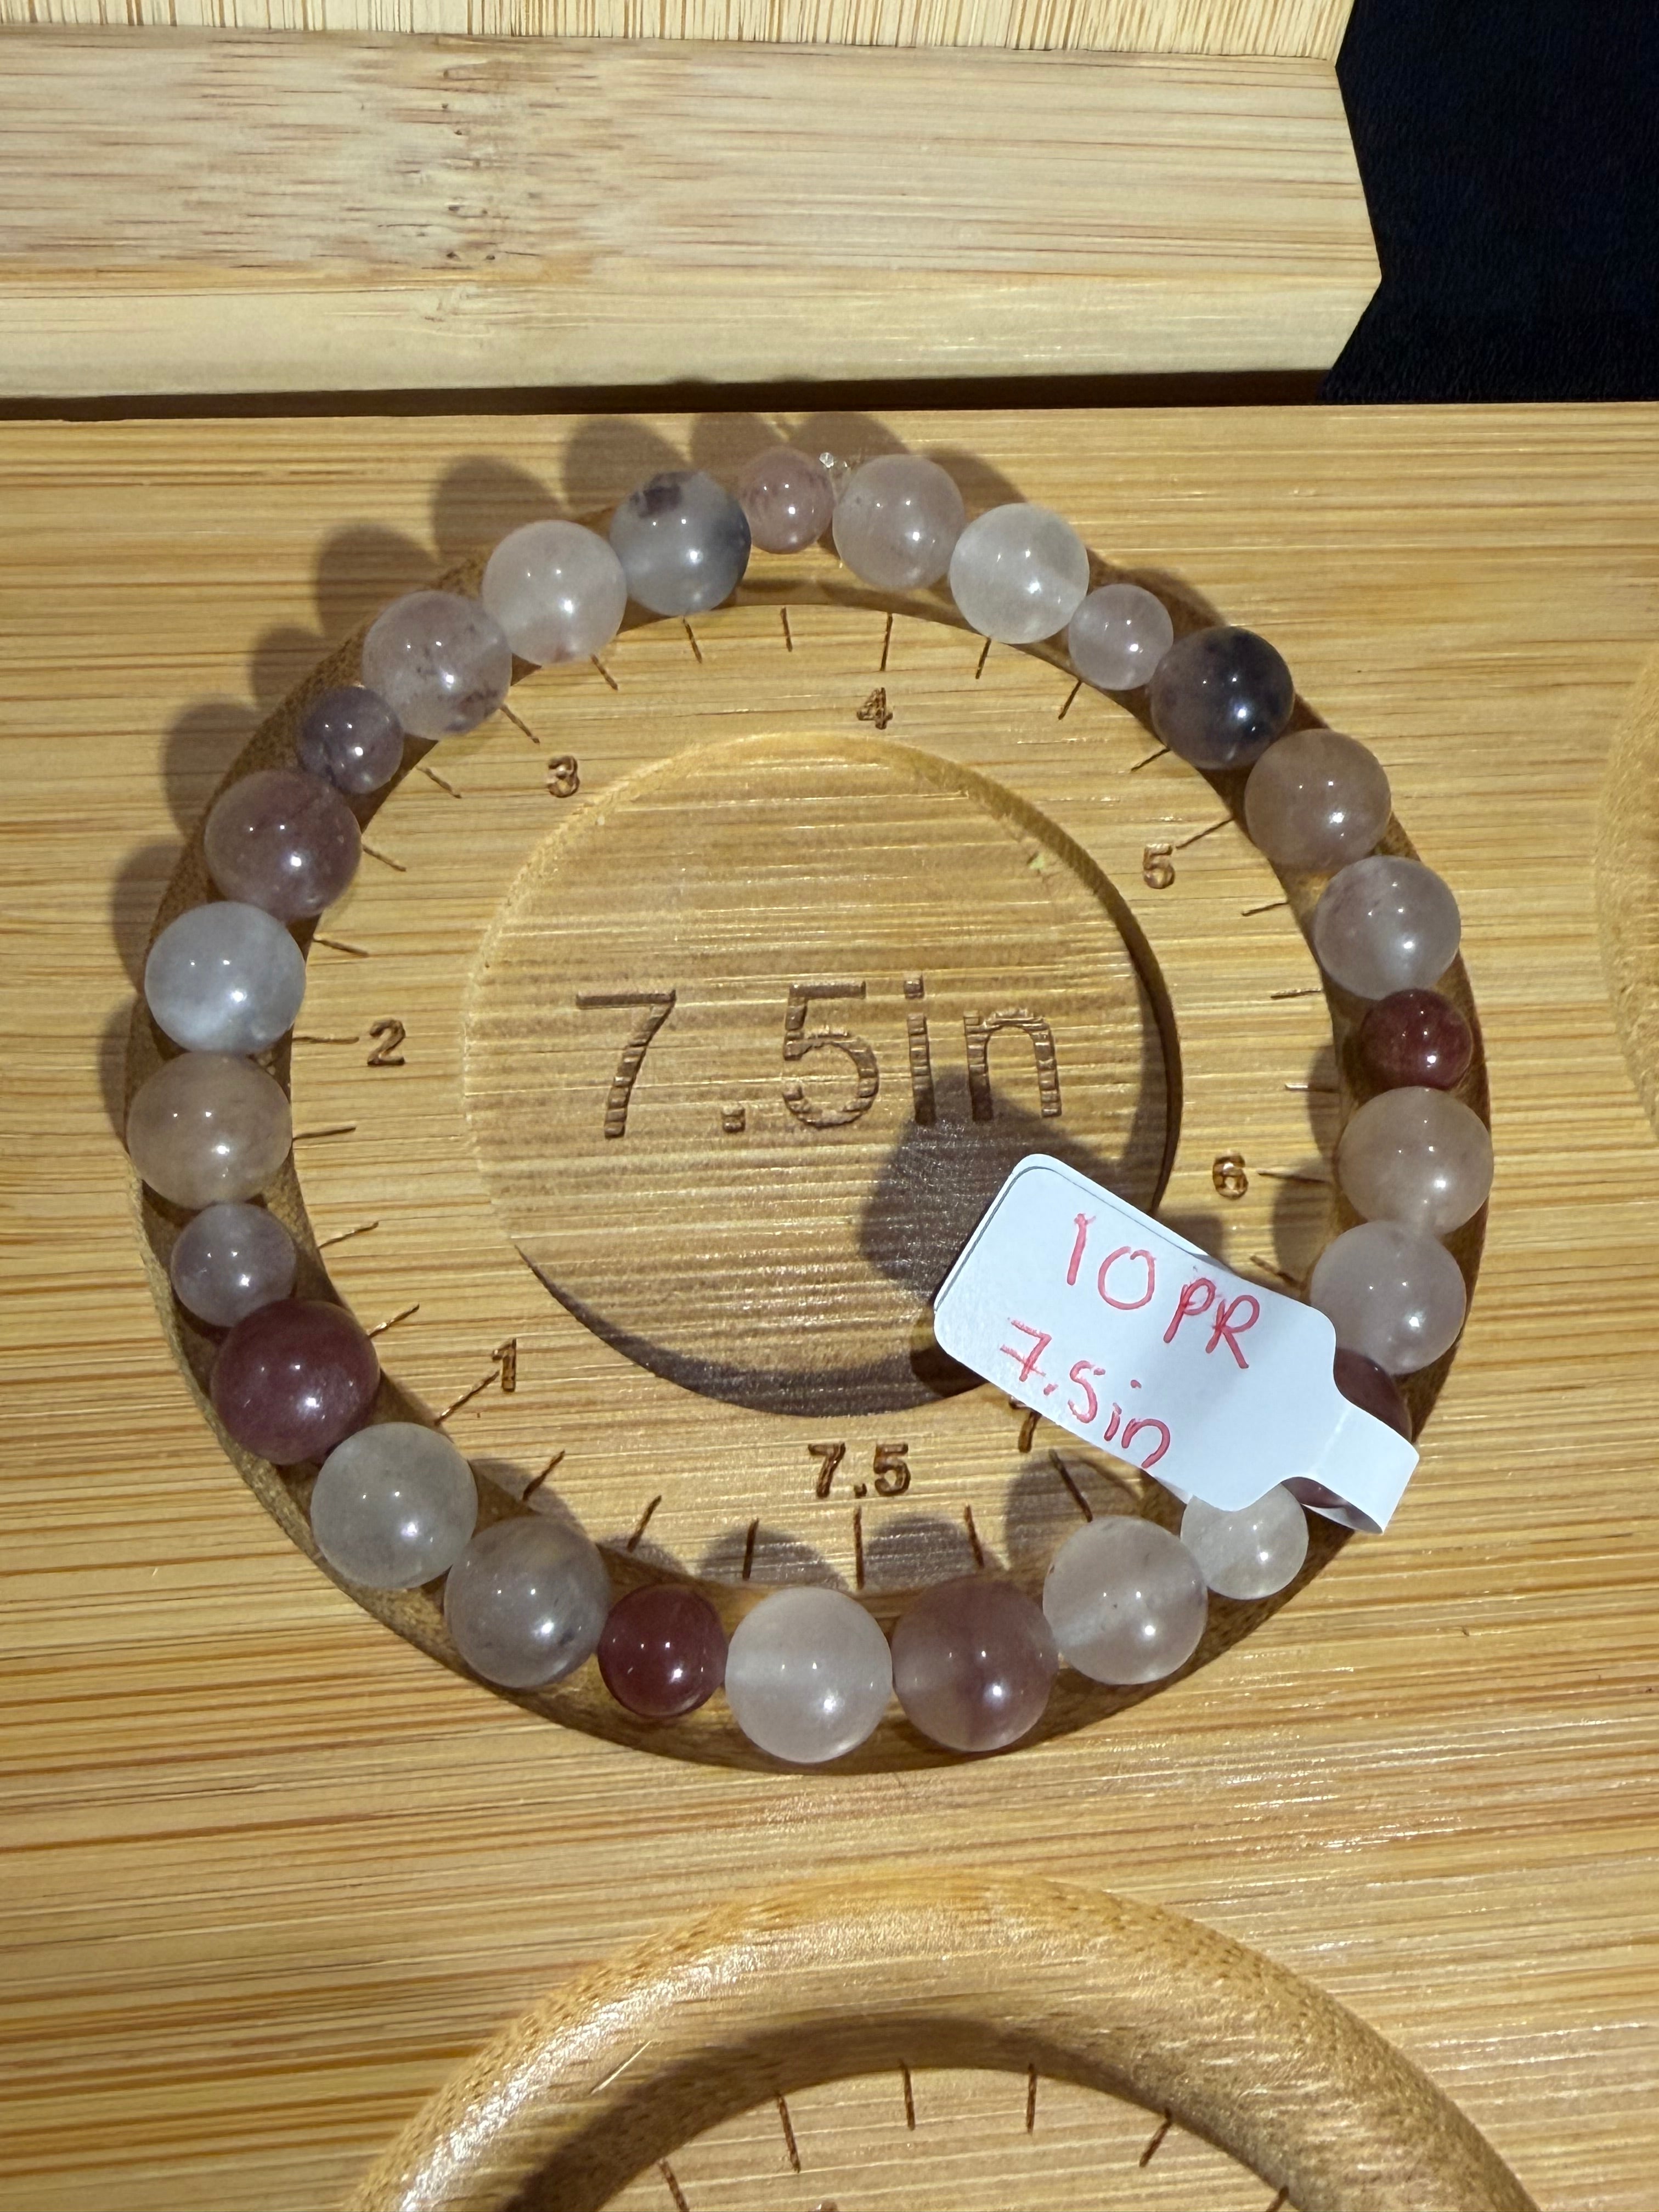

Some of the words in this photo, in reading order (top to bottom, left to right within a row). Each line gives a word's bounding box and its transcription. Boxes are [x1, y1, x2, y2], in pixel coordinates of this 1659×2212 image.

[856, 687, 894, 730] 4
[548, 755, 580, 798] 3
[1142, 843, 1175, 889] 5
[366, 1017, 406, 1066] 2
[575, 973, 1063, 1138] 7.5in
[1212, 1150, 1249, 1200] 6
[492, 1338, 517, 1392] 1
[808, 1441, 911, 1499] 7.5
